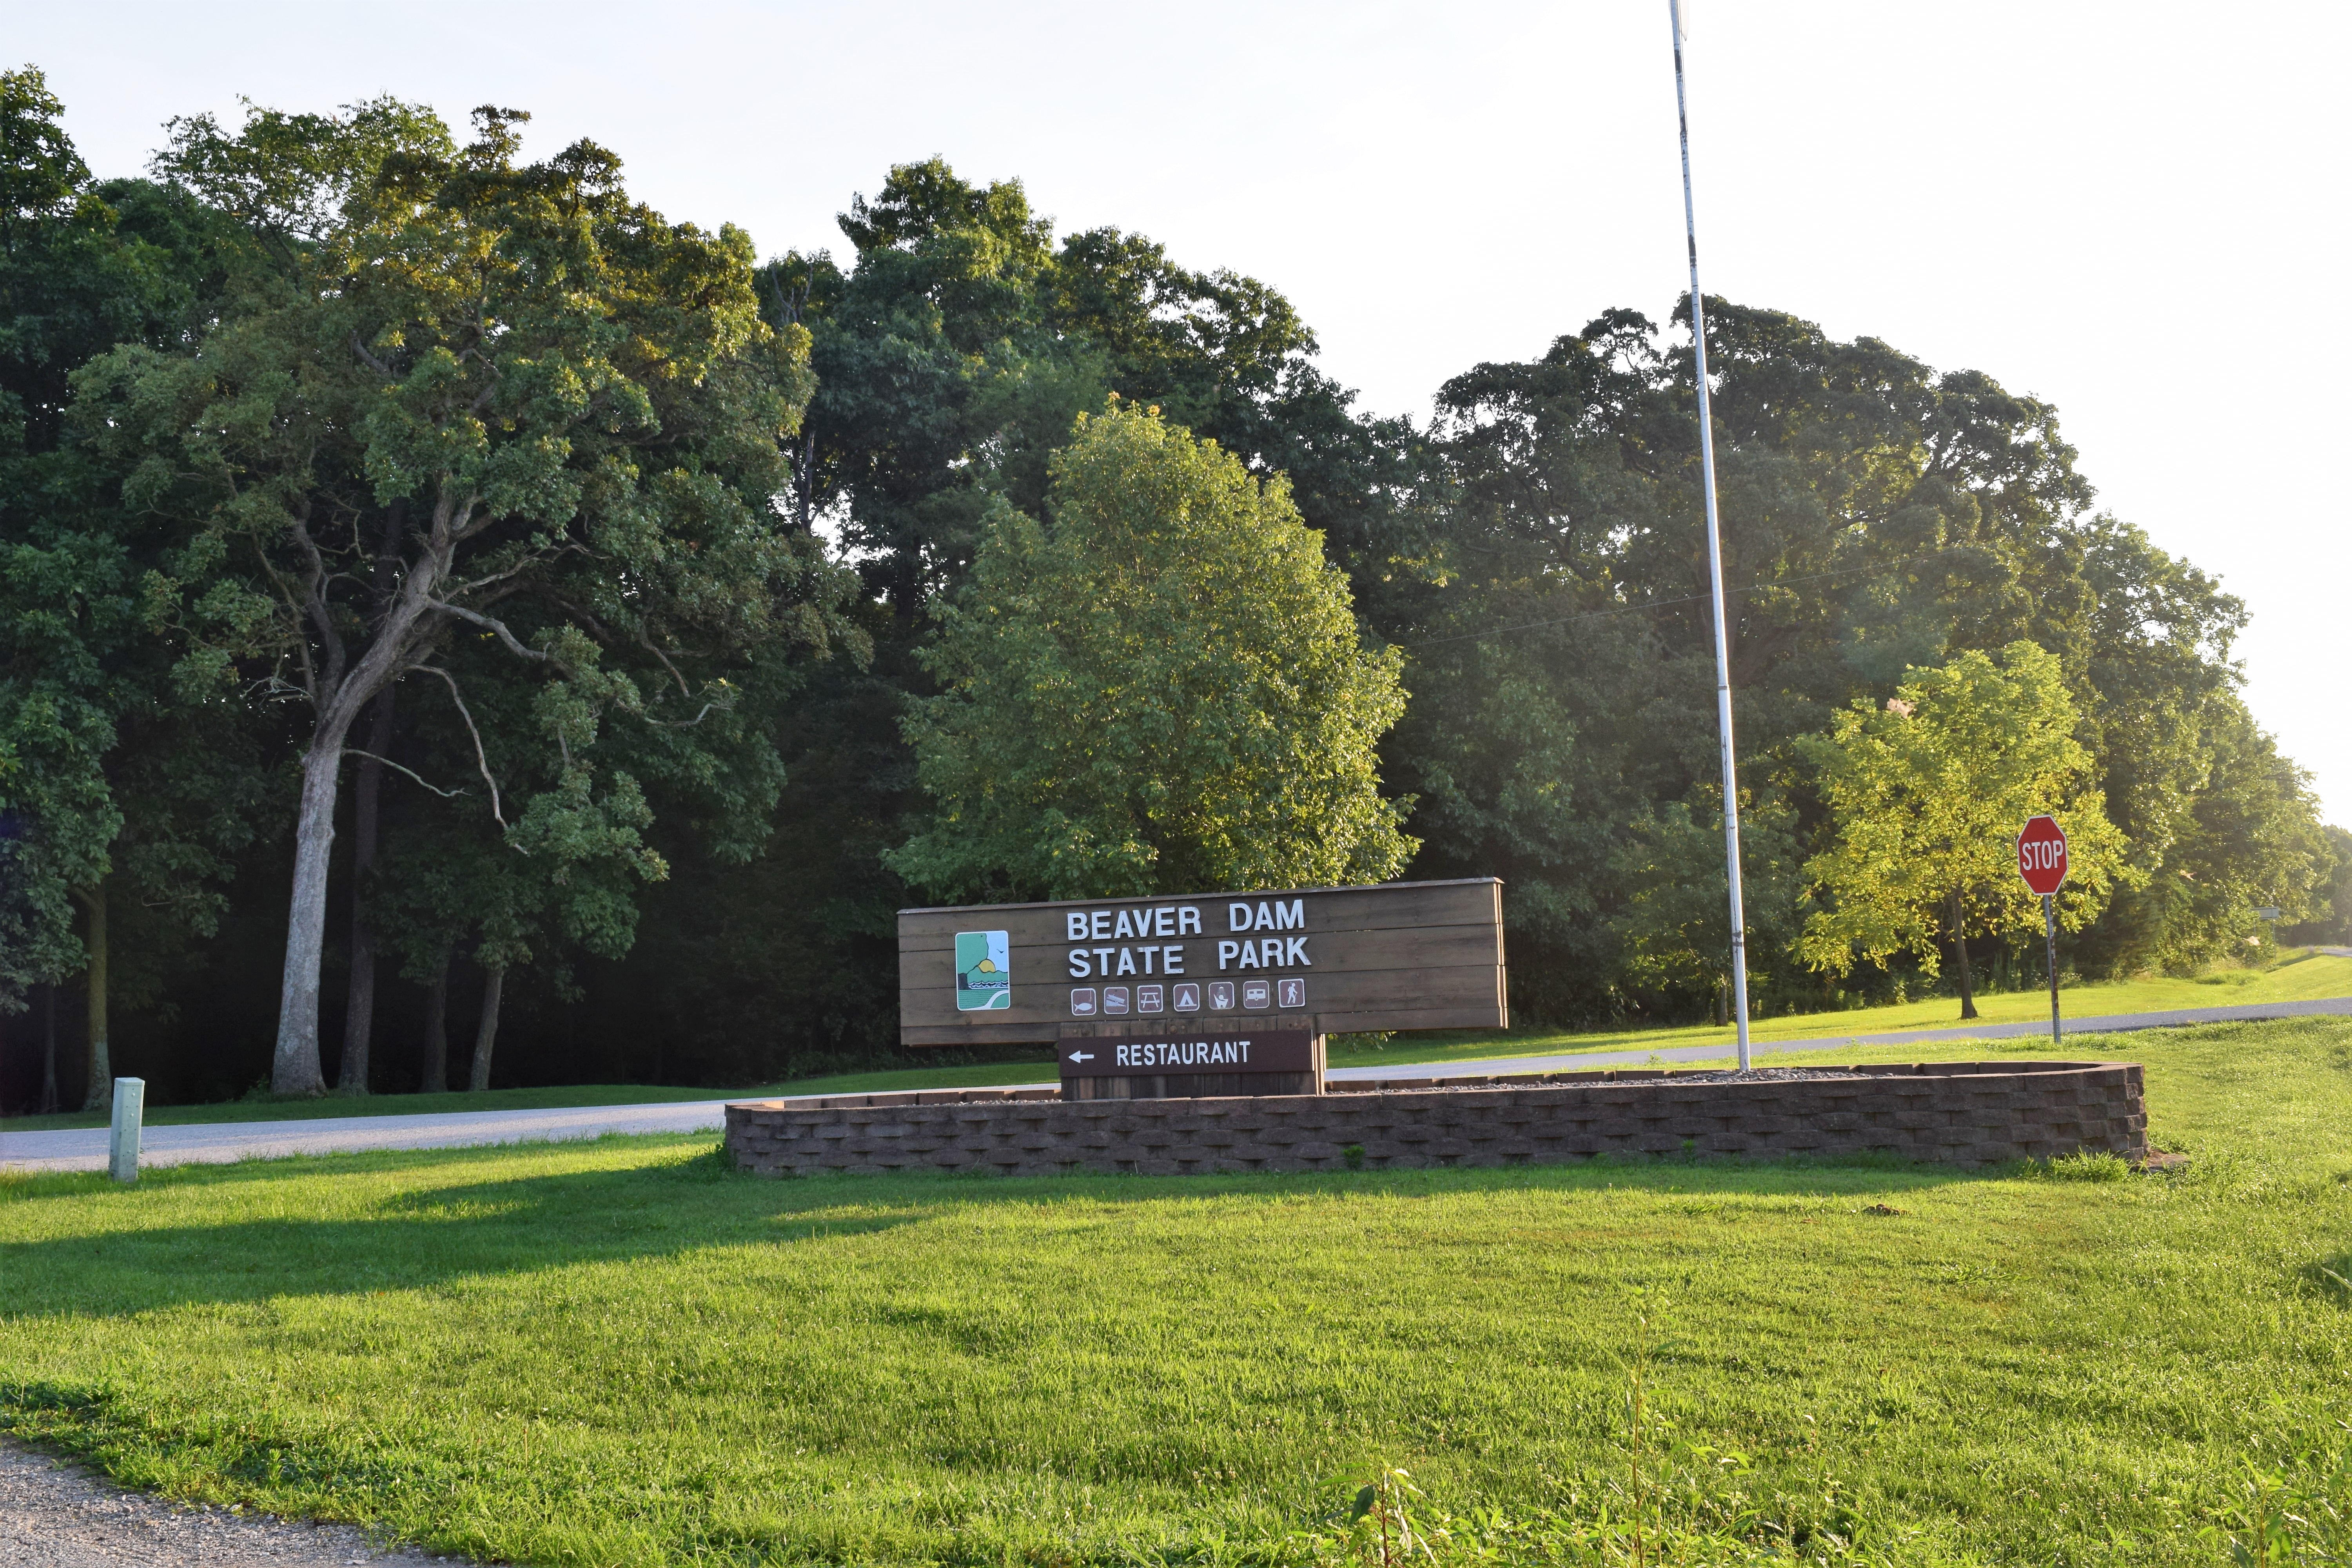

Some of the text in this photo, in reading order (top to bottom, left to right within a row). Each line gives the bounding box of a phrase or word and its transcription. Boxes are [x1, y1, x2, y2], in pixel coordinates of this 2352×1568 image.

[2022, 840, 2063, 871] STOP
[1067, 899, 1305, 940] BEAVER DAM
[1069, 937, 1312, 978] STATE PARK
[1116, 1041, 1250, 1066] RESTAURANT
